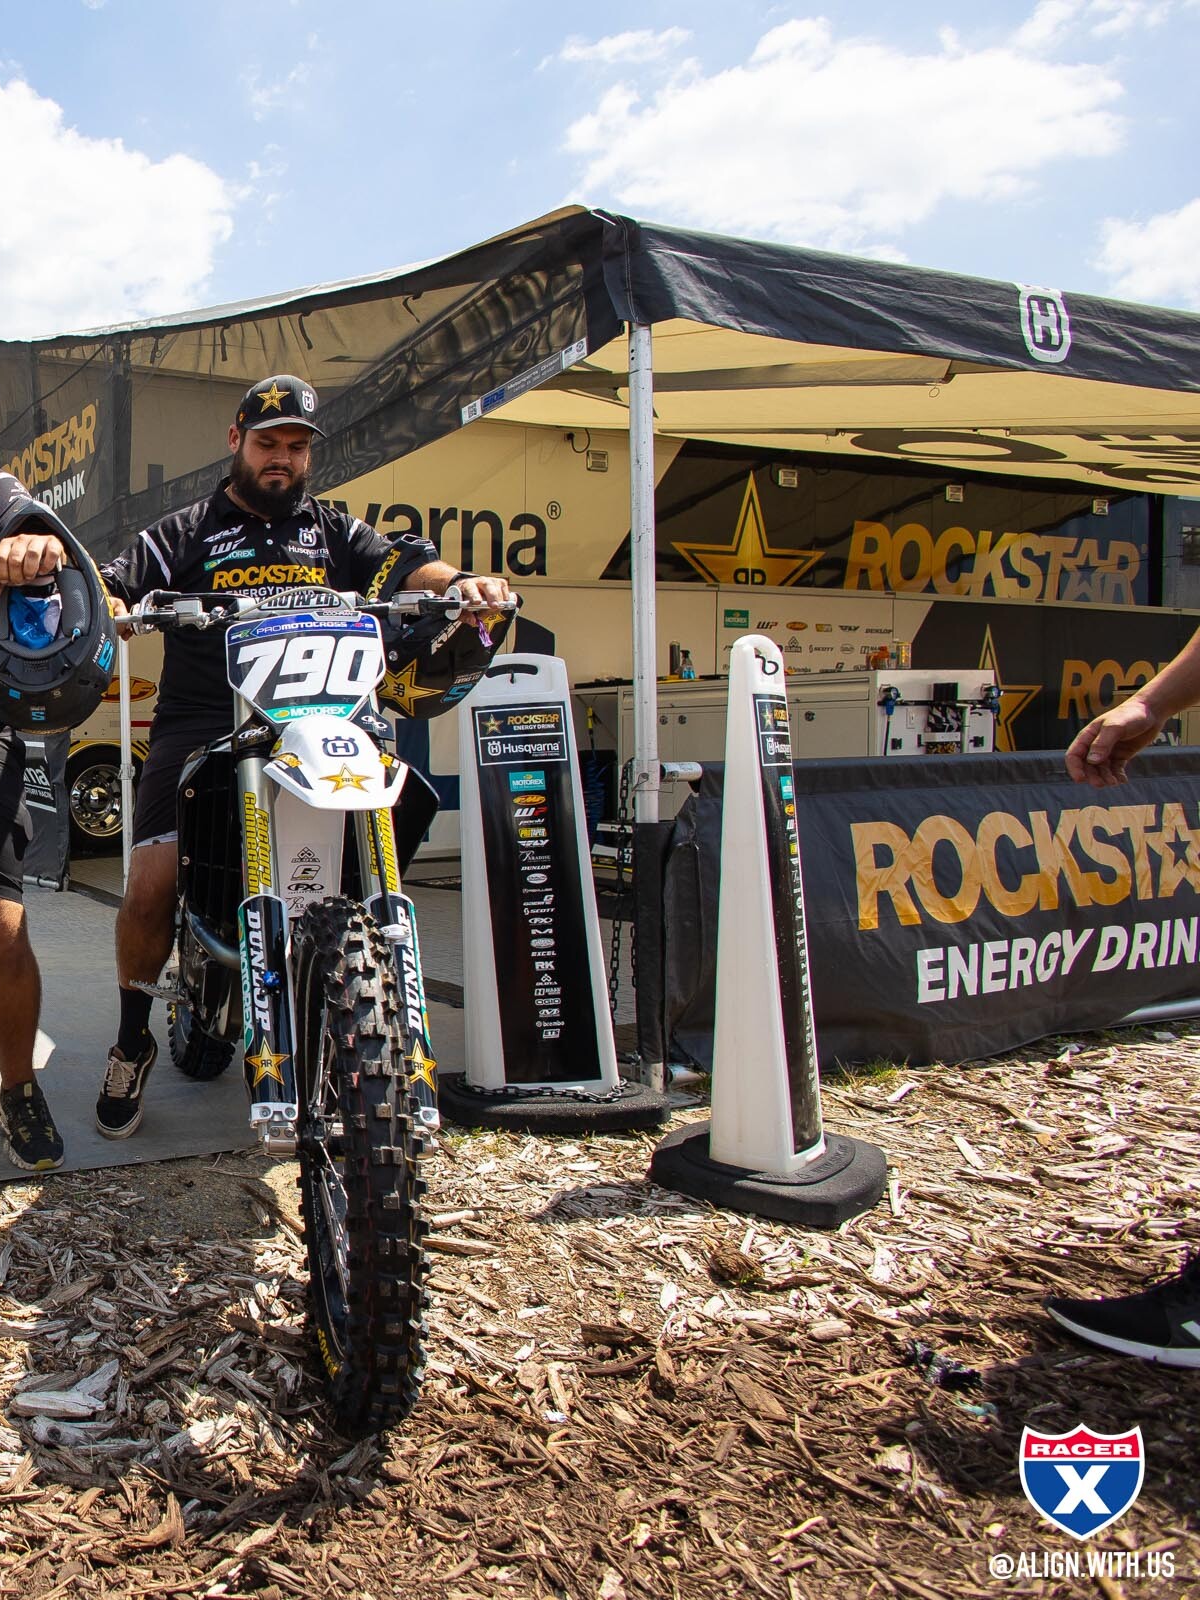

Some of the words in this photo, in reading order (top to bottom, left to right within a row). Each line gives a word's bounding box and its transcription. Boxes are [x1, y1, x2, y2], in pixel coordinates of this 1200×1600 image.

[3, 403, 97, 490] OCKSTAR
[43, 469, 86, 510] DRINK
[209, 536, 247, 557] WP
[844, 520, 1142, 606] ROCKSTAR
[212, 565, 326, 590] ROCKSTAR
[225, 586, 274, 599] ENERGY
[237, 635, 383, 701] 790
[290, 705, 346, 717] MOTOREX
[507, 714, 560, 725] ROCKSTAR
[502, 741, 560, 755] Husqvarna
[512, 779, 544, 787] MOTOREX
[514, 807, 548, 818] WP
[850, 802, 1200, 931] ROCKSTA
[397, 905, 425, 1035] DUNLP
[535, 961, 555, 971] RK
[916, 928, 1095, 1004] ENERGY
